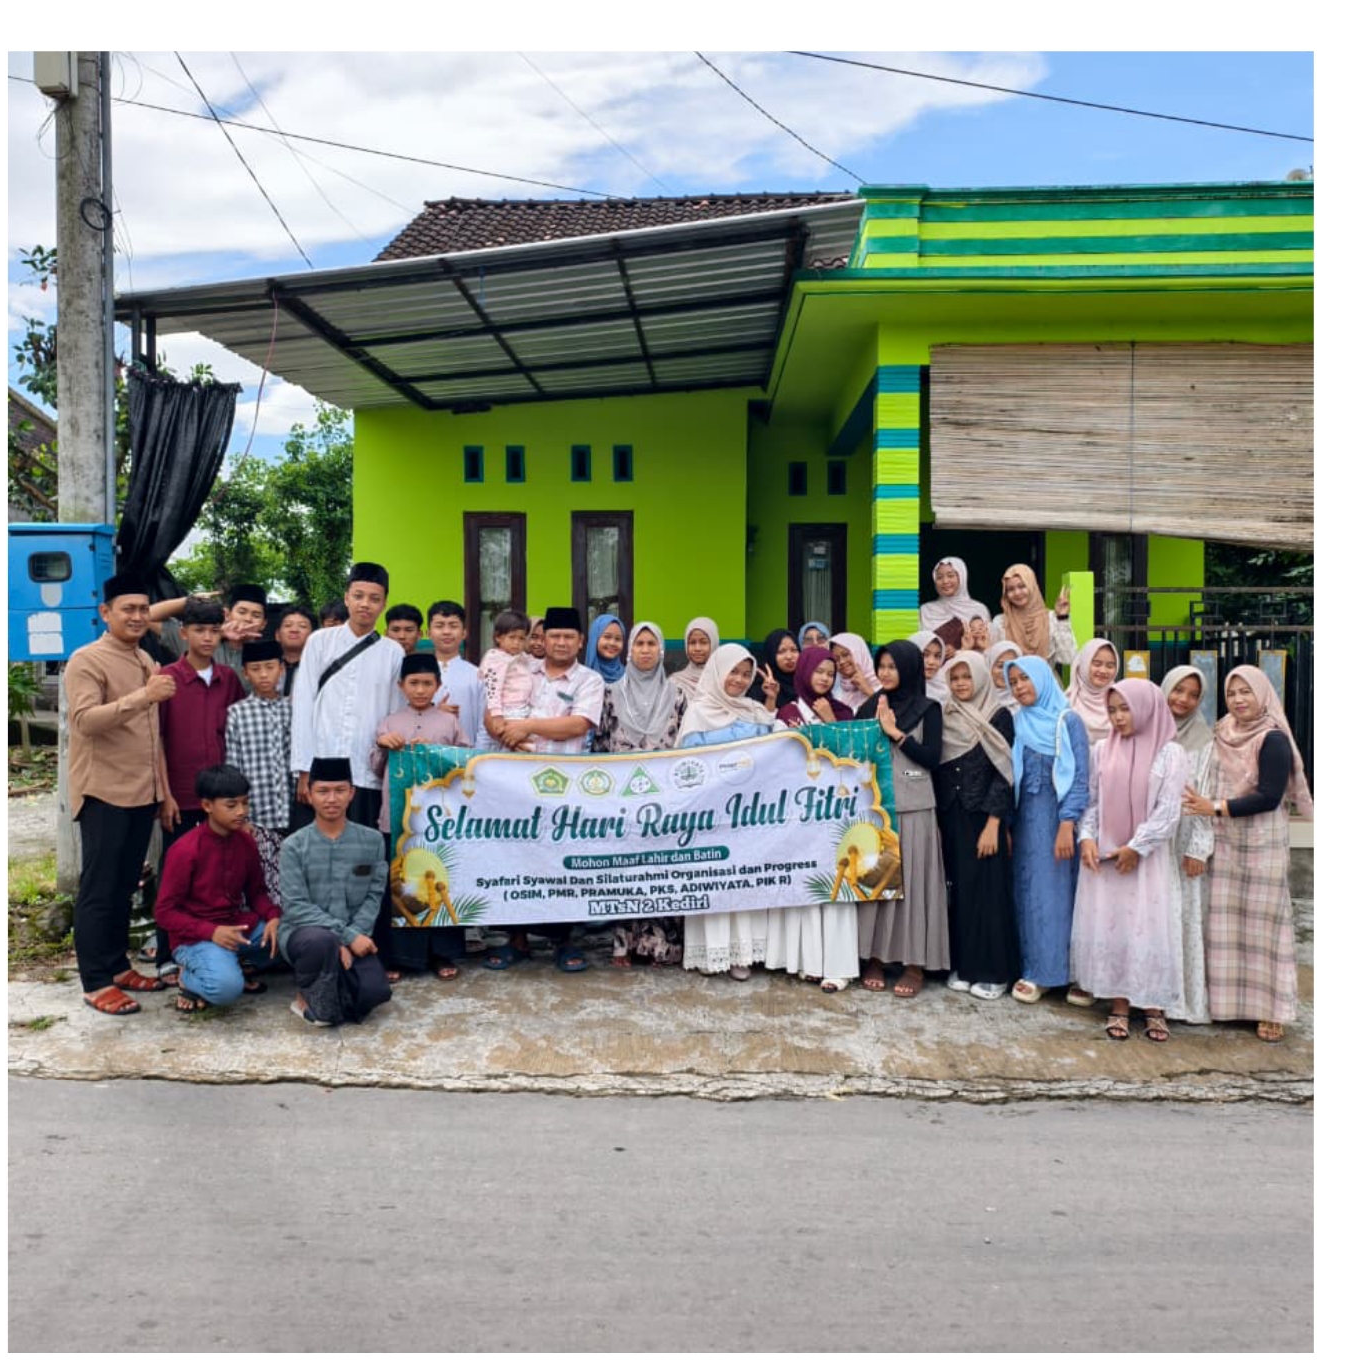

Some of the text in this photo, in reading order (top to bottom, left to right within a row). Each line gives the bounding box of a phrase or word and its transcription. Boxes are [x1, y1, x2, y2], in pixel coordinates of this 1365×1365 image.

[423, 785, 860, 847] Selamat Hari Raya Idul Fitri
[571, 849, 722, 869] Mohon Maaf Lahir dan Batin
[476, 860, 817, 888] Syafari Syawal Dan Silaturahmi Organisasi dan Progress
[547, 888, 578, 899] PMR,
[581, 886, 648, 898] PRAMUKA,
[756, 877, 777, 888] PIK
[778, 875, 792, 886] R)
[588, 894, 710, 916] MTsN 2 Kediri
